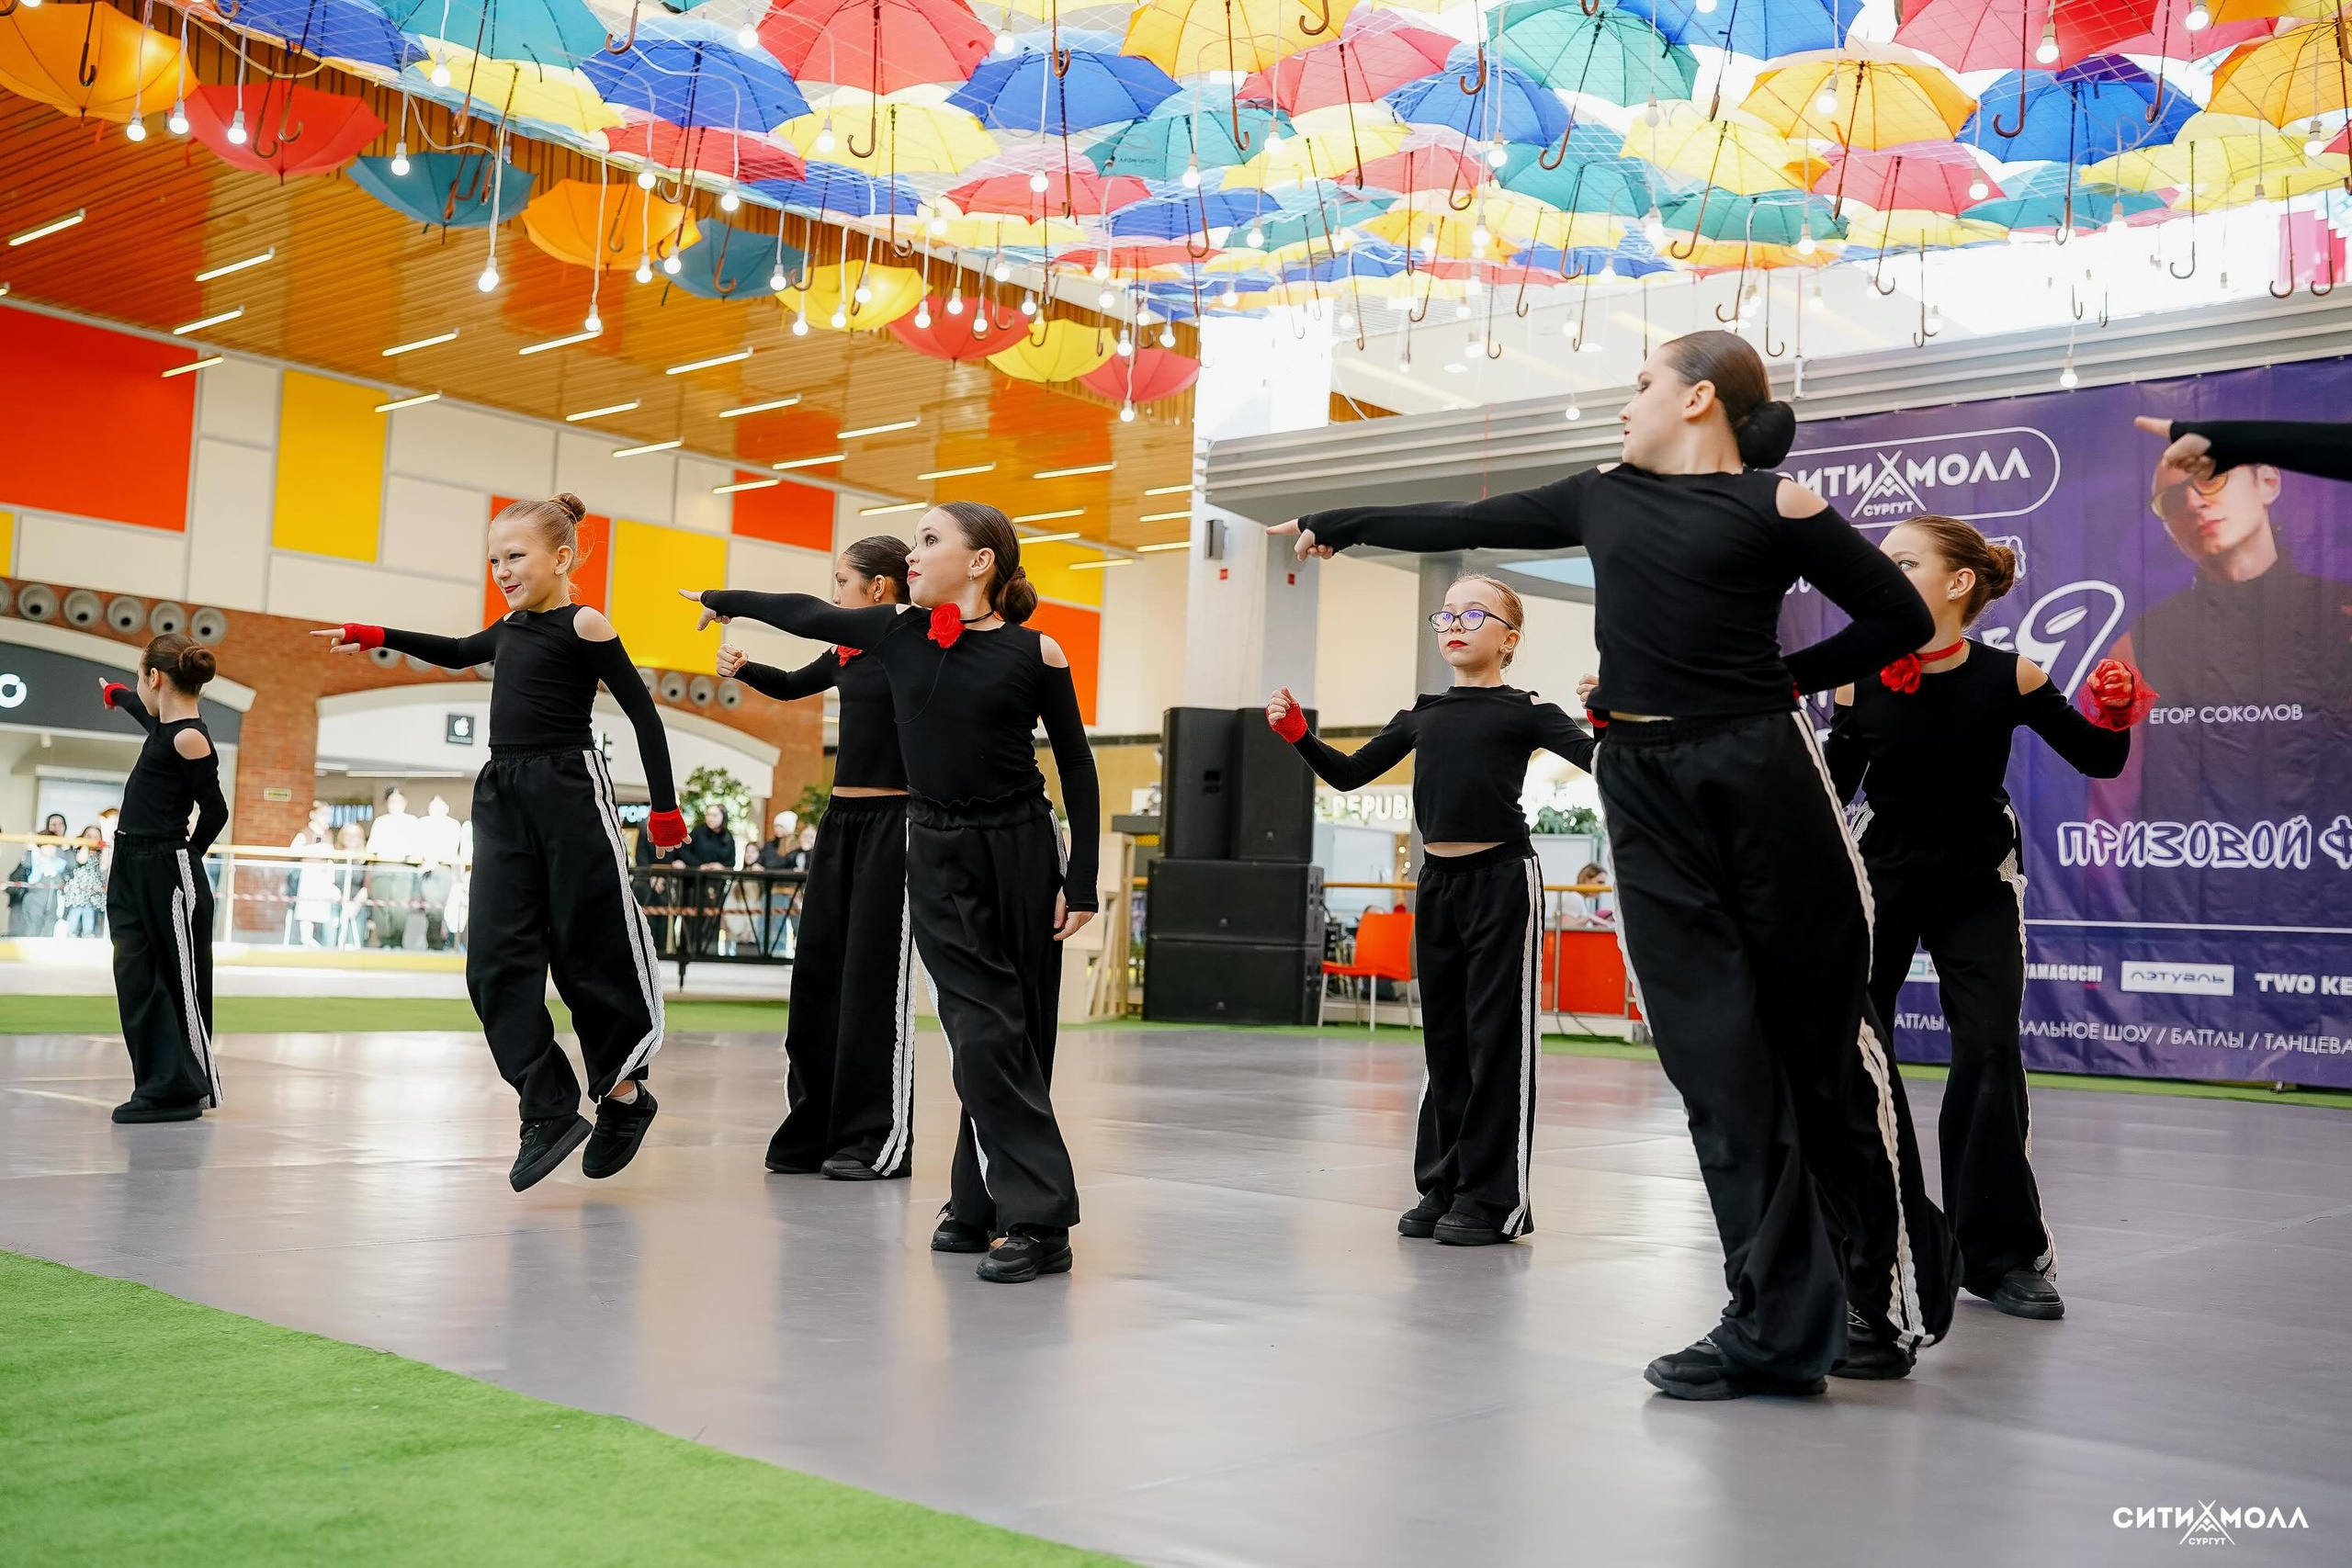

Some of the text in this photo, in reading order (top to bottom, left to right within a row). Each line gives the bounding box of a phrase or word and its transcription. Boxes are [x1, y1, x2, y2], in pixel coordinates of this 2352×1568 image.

[1776, 462, 1873, 498] ИТИ
[1863, 500, 1915, 517] СУРГУТ
[2149, 704, 2303, 725] ЕГОР СОКОЛОВ
[2057, 815, 2312, 870] ПРИЗОВОЙ
[2026, 963, 2101, 983] AMAGUCHI
[2254, 972, 2316, 995] TWO
[2103, 1023, 2154, 1043] ШОУ
[2170, 1027, 2245, 1049] БАТТЛЫ
